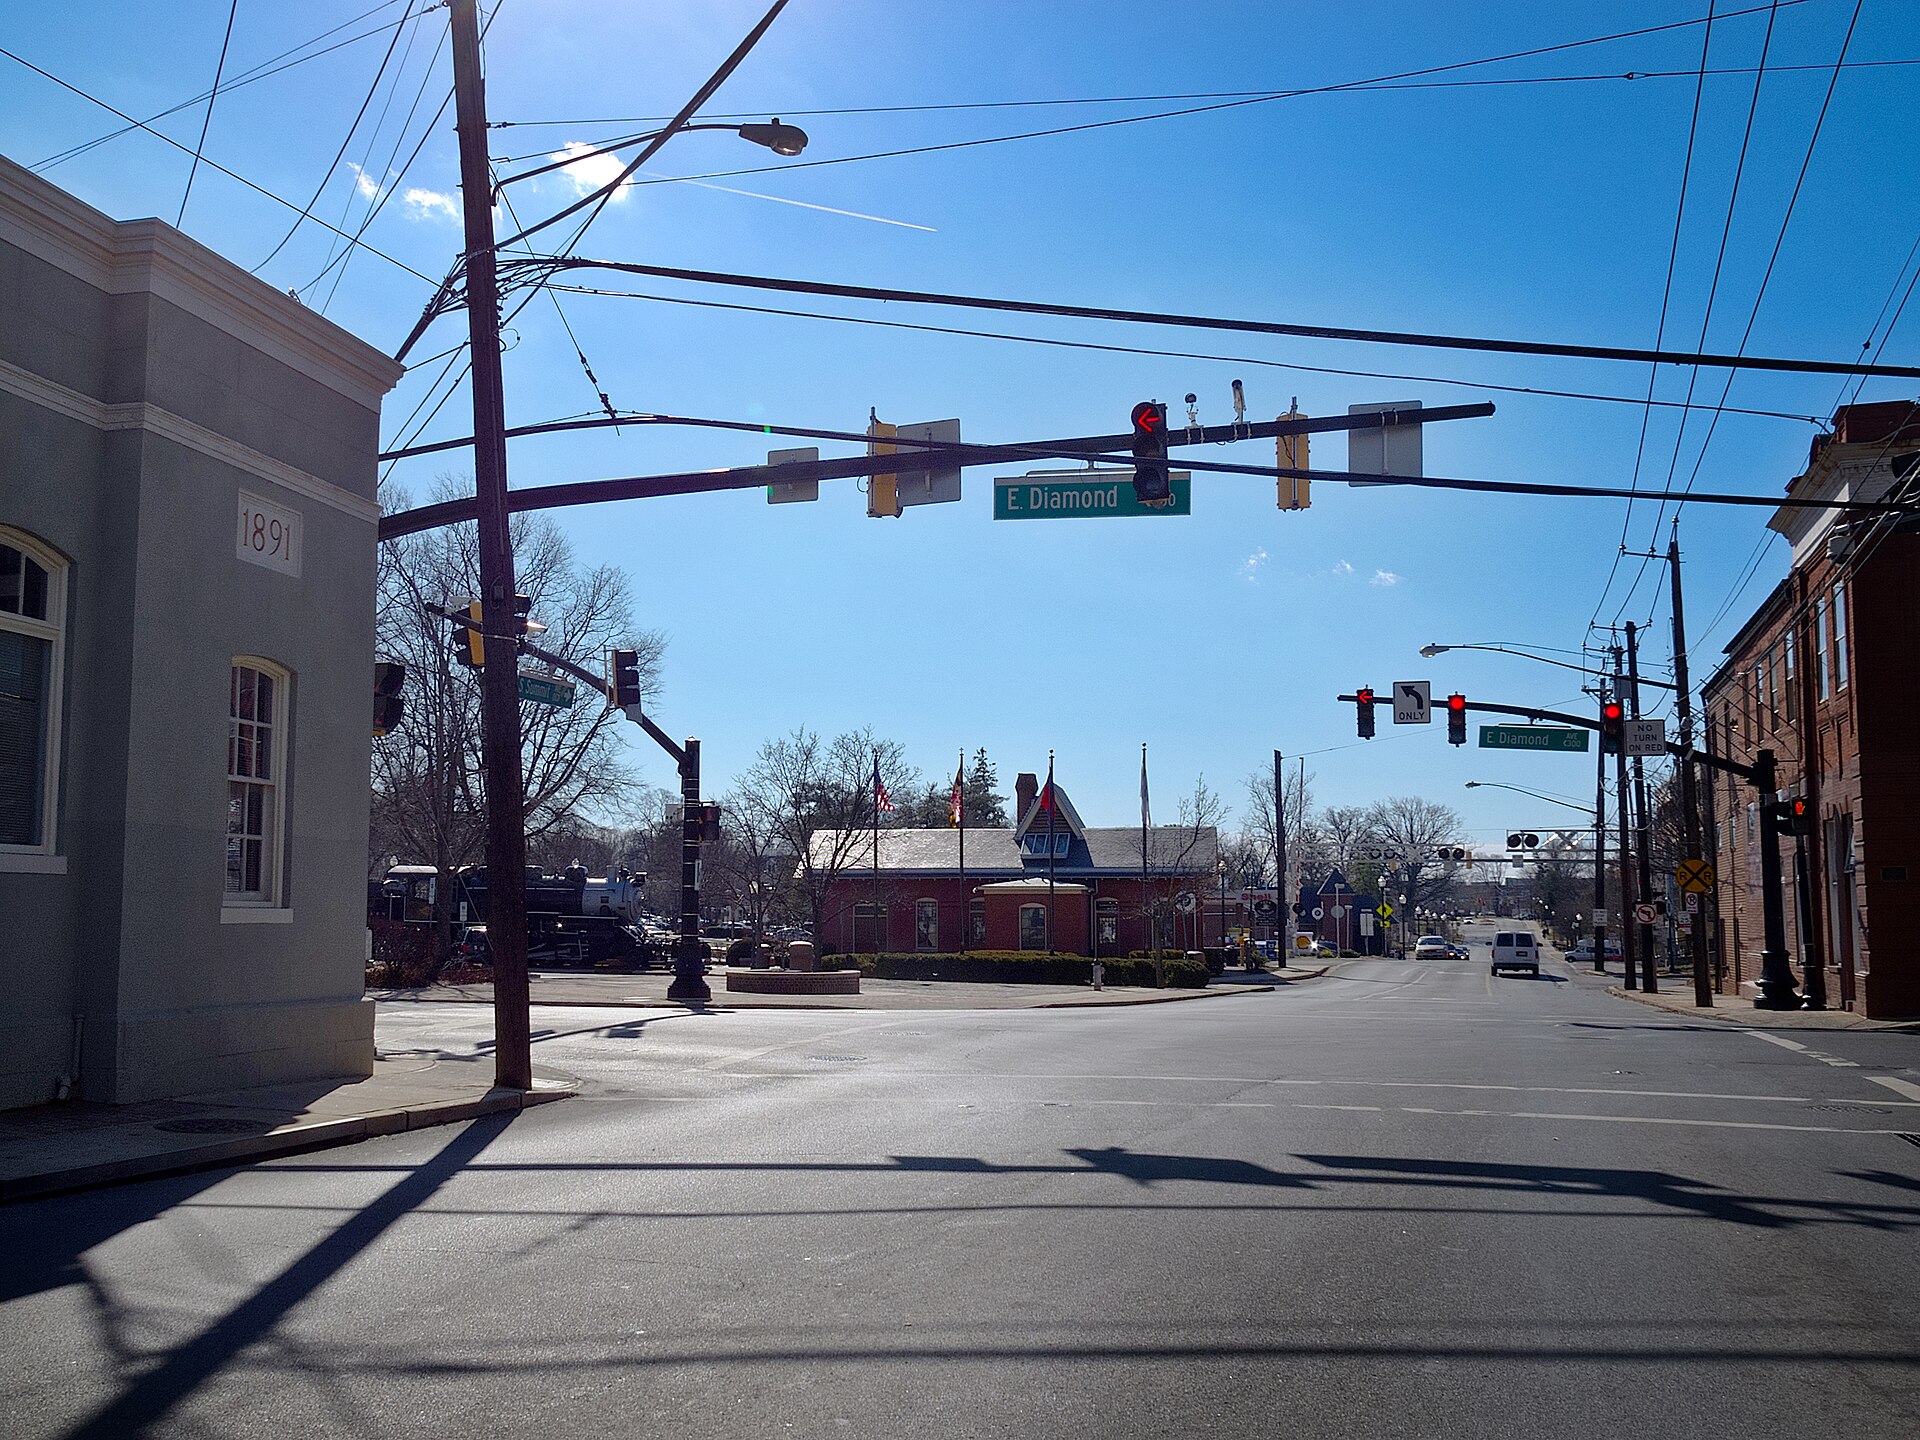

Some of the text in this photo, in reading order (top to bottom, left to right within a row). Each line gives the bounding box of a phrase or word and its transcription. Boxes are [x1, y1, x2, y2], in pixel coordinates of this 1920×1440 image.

[1007, 487, 1023, 510] E.
[1030, 485, 1118, 509] Diamond
[243, 507, 291, 561] 1891
[1399, 711, 1425, 720] ONLY
[1637, 724, 1653, 732] NO
[1499, 731, 1549, 746] Diamond
[1633, 734, 1658, 742] TURN
[1628, 743, 1663, 752] ON RED
[1679, 871, 1712, 881] R R
